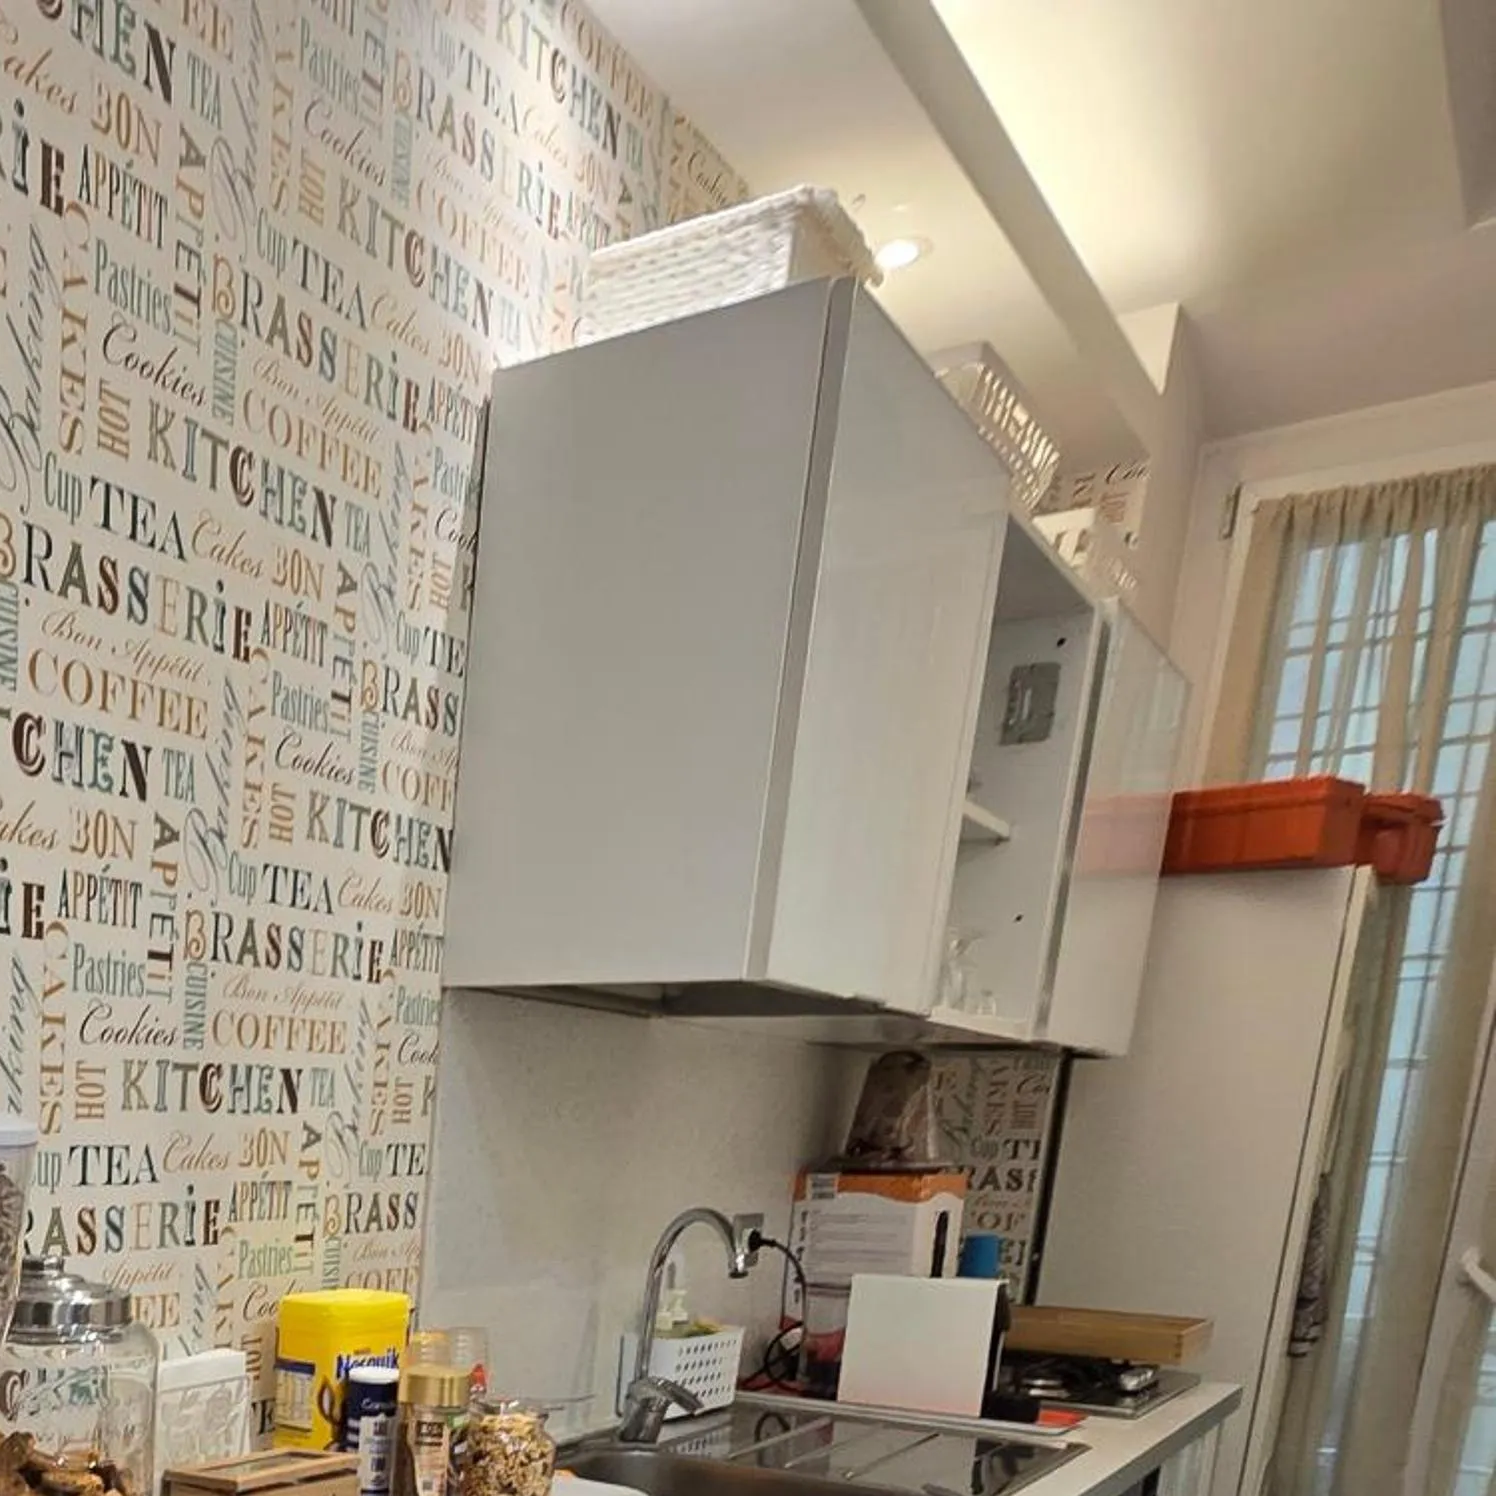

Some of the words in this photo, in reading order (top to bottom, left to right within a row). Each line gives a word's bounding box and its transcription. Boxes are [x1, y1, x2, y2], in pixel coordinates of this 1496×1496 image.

[187, 49, 222, 132] TEA
[496, 4, 621, 161] KITCHEN
[90, 69, 163, 167] BON
[77, 143, 168, 251] APPÉTIT
[94, 236, 171, 334] Pastries
[292, 235, 367, 331] TEA
[337, 176, 494, 337] KITCHEN
[102, 311, 205, 406] Cookies
[97, 377, 130, 462] HOT
[241, 390, 381, 499] COFFEE
[44, 450, 81, 525] Cup
[90, 473, 187, 562] TEA
[191, 510, 263, 577] Cakes
[271, 538, 325, 601] BON
[42, 611, 100, 650] Bon
[112, 638, 203, 681] Appétit
[426, 627, 466, 680] TE
[30, 649, 206, 740] COFFEE
[161, 747, 195, 803] TEA
[275, 726, 352, 785] Cookies
[69, 803, 137, 860] BON
[306, 789, 454, 874] KITCHEN
[57, 863, 142, 929] APPÉTIT
[263, 861, 335, 915] TEA
[399, 878, 442, 919] BON
[72, 942, 144, 997] Pastries
[79, 997, 176, 1046] Cookies
[212, 1009, 346, 1053] COFFEE
[74, 1059, 105, 1120] HOT
[68, 1144, 159, 1186] TEA
[162, 1131, 230, 1172] Cakes
[238, 1128, 290, 1167] BON
[387, 1143, 425, 1176] TE
